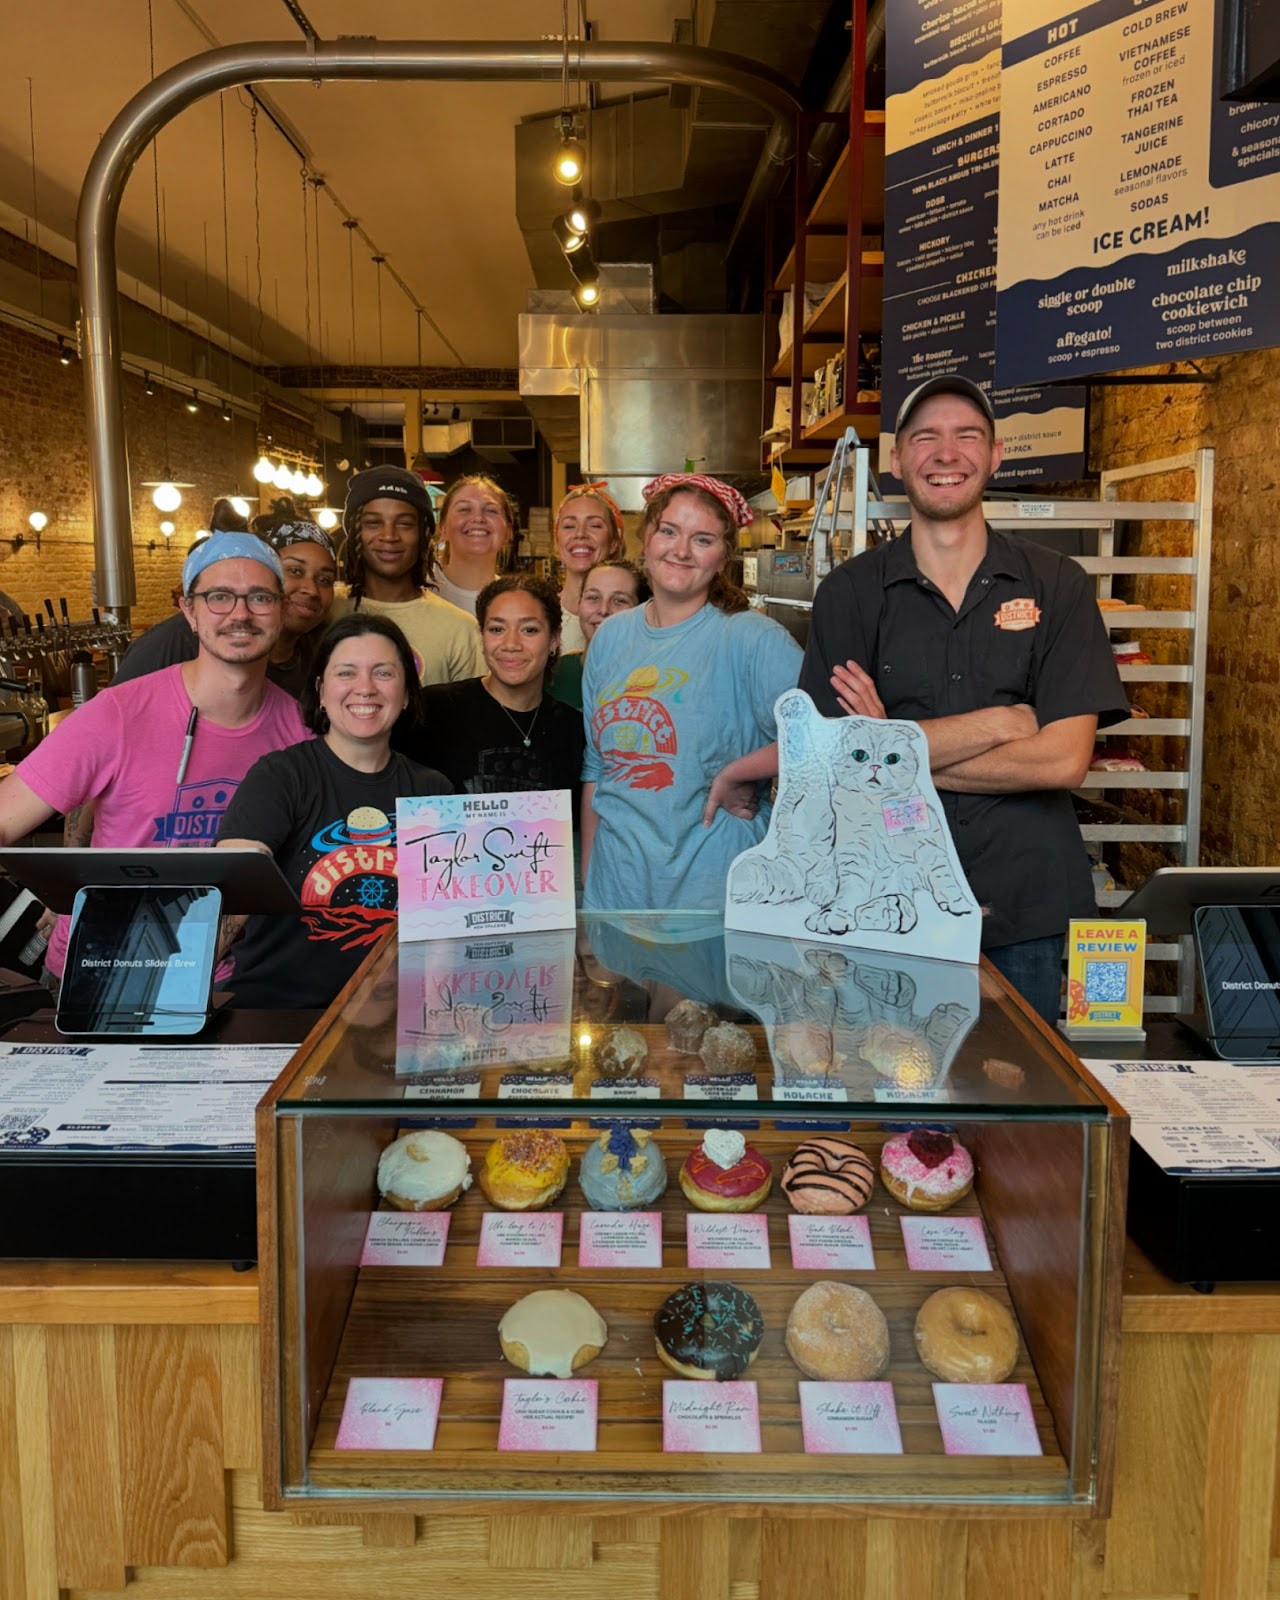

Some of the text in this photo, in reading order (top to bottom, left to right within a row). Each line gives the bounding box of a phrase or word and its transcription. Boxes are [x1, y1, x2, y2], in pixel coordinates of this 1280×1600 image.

[1122, 1, 1188, 36] COLD BREW
[1047, 18, 1078, 44] HOT
[1119, 25, 1192, 62] VIETNAMESE
[1044, 46, 1081, 69] COFFEE
[1134, 46, 1176, 71] COFFEE
[1037, 64, 1088, 92] ESPRESSO
[1122, 54, 1186, 86] frozen or iced
[1033, 84, 1092, 114] AMERICANO
[1131, 79, 1175, 103] FROZEN
[1127, 94, 1178, 119] THAI TEA
[1038, 107, 1085, 132] CORTADO
[1121, 115, 1184, 144] TANGERINE
[1240, 115, 1280, 134] chicory
[932, 140, 956, 156] LUNCH
[964, 125, 993, 144] DINNER
[1030, 126, 1093, 155] CAPPUCCINO
[1134, 135, 1168, 154] JUICE
[1045, 152, 1076, 170] LATTE
[1232, 146, 1239, 158] &
[1238, 147, 1280, 167] specials
[1120, 156, 1182, 182] LEMONADE
[1048, 174, 1072, 190] CHAI
[1114, 168, 1188, 196] seasonal flavors
[1039, 192, 1080, 212] MATCHA
[1130, 193, 1168, 212] SODAS
[1032, 210, 1085, 231] any hot drink
[1036, 220, 1081, 240] can be iced
[1094, 206, 1209, 254] ICE CREAM!
[919, 236, 950, 252] HICKORY
[1166, 248, 1246, 276] milkshake
[1038, 277, 1136, 309] single or double
[1152, 274, 1262, 308] chocolate chip
[1066, 300, 1102, 316] scoop
[1162, 294, 1248, 322] cookiewich
[902, 318, 932, 333] CHICKEN
[940, 310, 966, 324] PICKLE
[1166, 315, 1242, 335] scoop between
[1056, 326, 1112, 348] affogato!
[1156, 327, 1252, 350] two district cookies
[1048, 352, 1072, 364] scoop
[1081, 344, 1120, 358] espresso
[463, 800, 508, 812] HELLO
[405, 827, 566, 891] Taylor Swift
[416, 870, 558, 902] TAKEOVER
[472, 911, 508, 924] DISTRICT
[1076, 929, 1138, 938] LEAVE A
[1076, 943, 1138, 952] REVIEW
[1222, 981, 1252, 990] District
[921, 1226, 966, 1238] Love Story
[360, 1402, 422, 1421] Blank Space
[669, 1400, 752, 1414] Midnight Rain
[816, 1402, 881, 1418] Shake it Off
[949, 1405, 1022, 1422] Sweet Nothing
